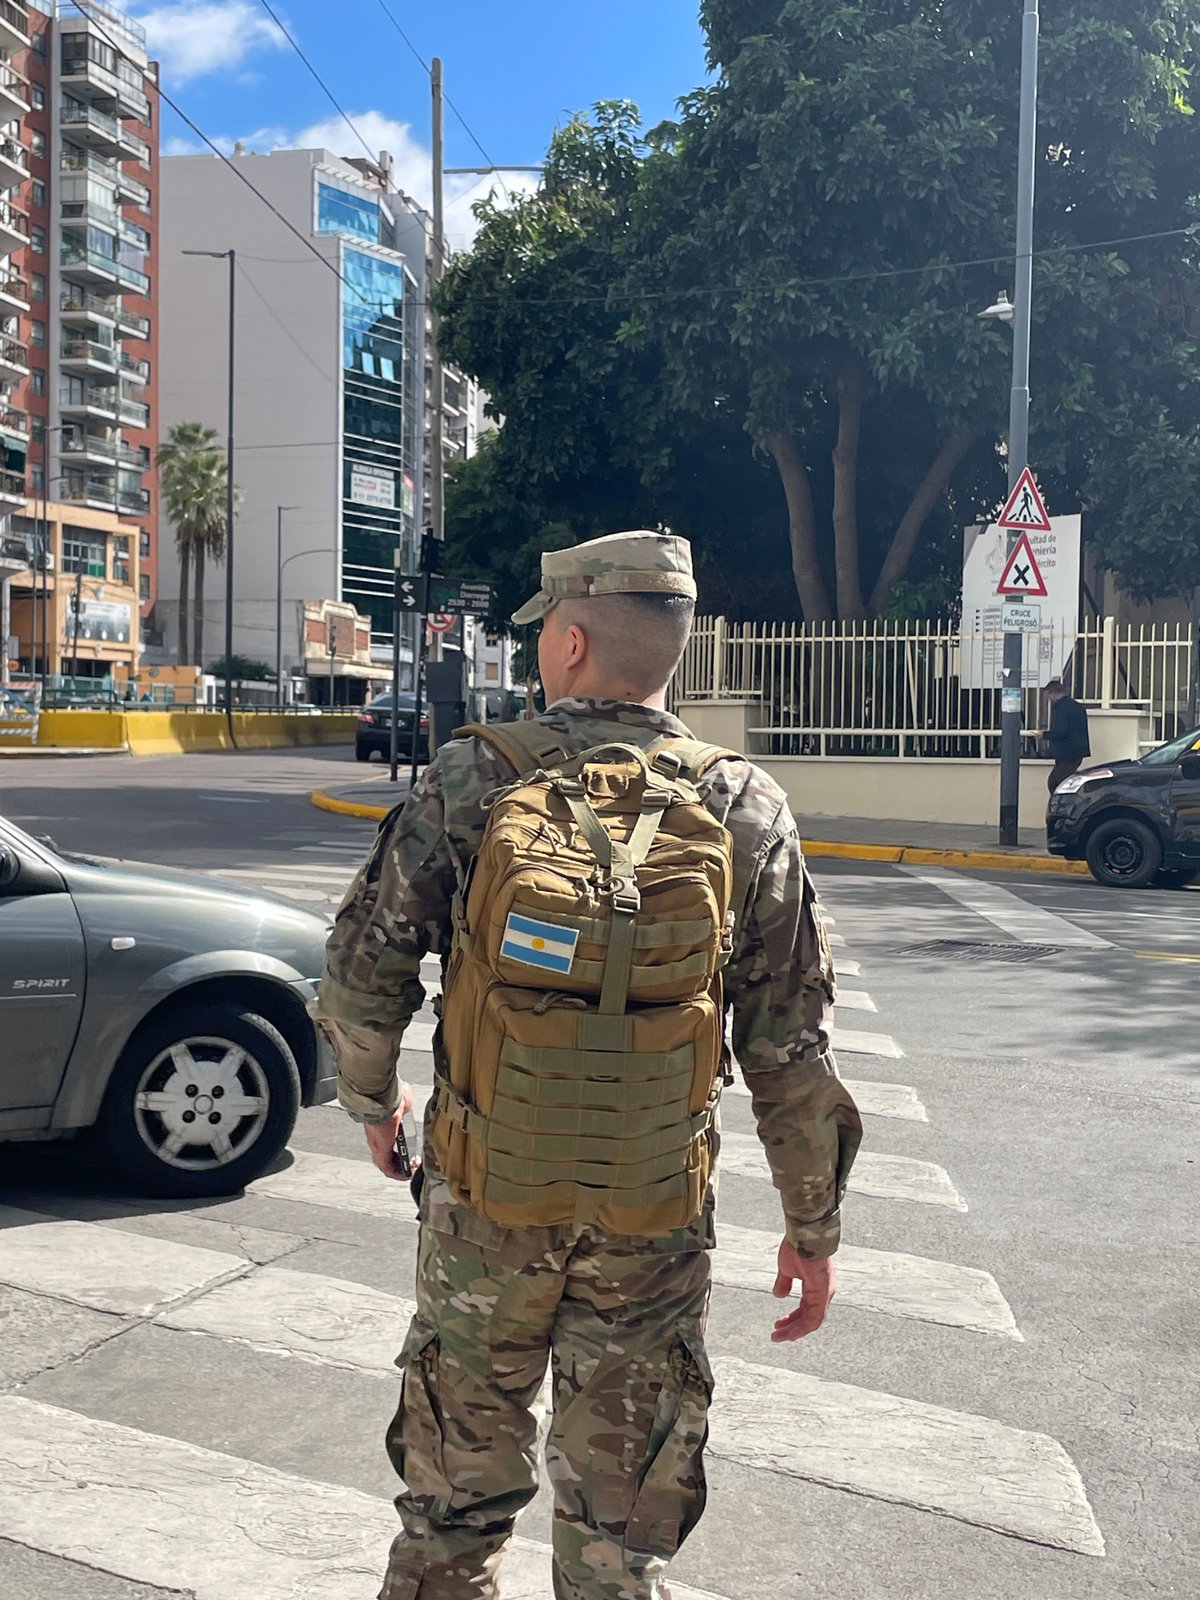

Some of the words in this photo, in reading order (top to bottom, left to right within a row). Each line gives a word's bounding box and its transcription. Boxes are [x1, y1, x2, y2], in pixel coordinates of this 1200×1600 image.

[1048, 533, 1057, 543] de
[461, 583, 490, 592] Avenida
[460, 591, 490, 601] Dorrego
[1010, 609, 1031, 617] CRUCE
[1003, 618, 1037, 627] PELIGROSO
[12, 978, 70, 990] SPIRIT
